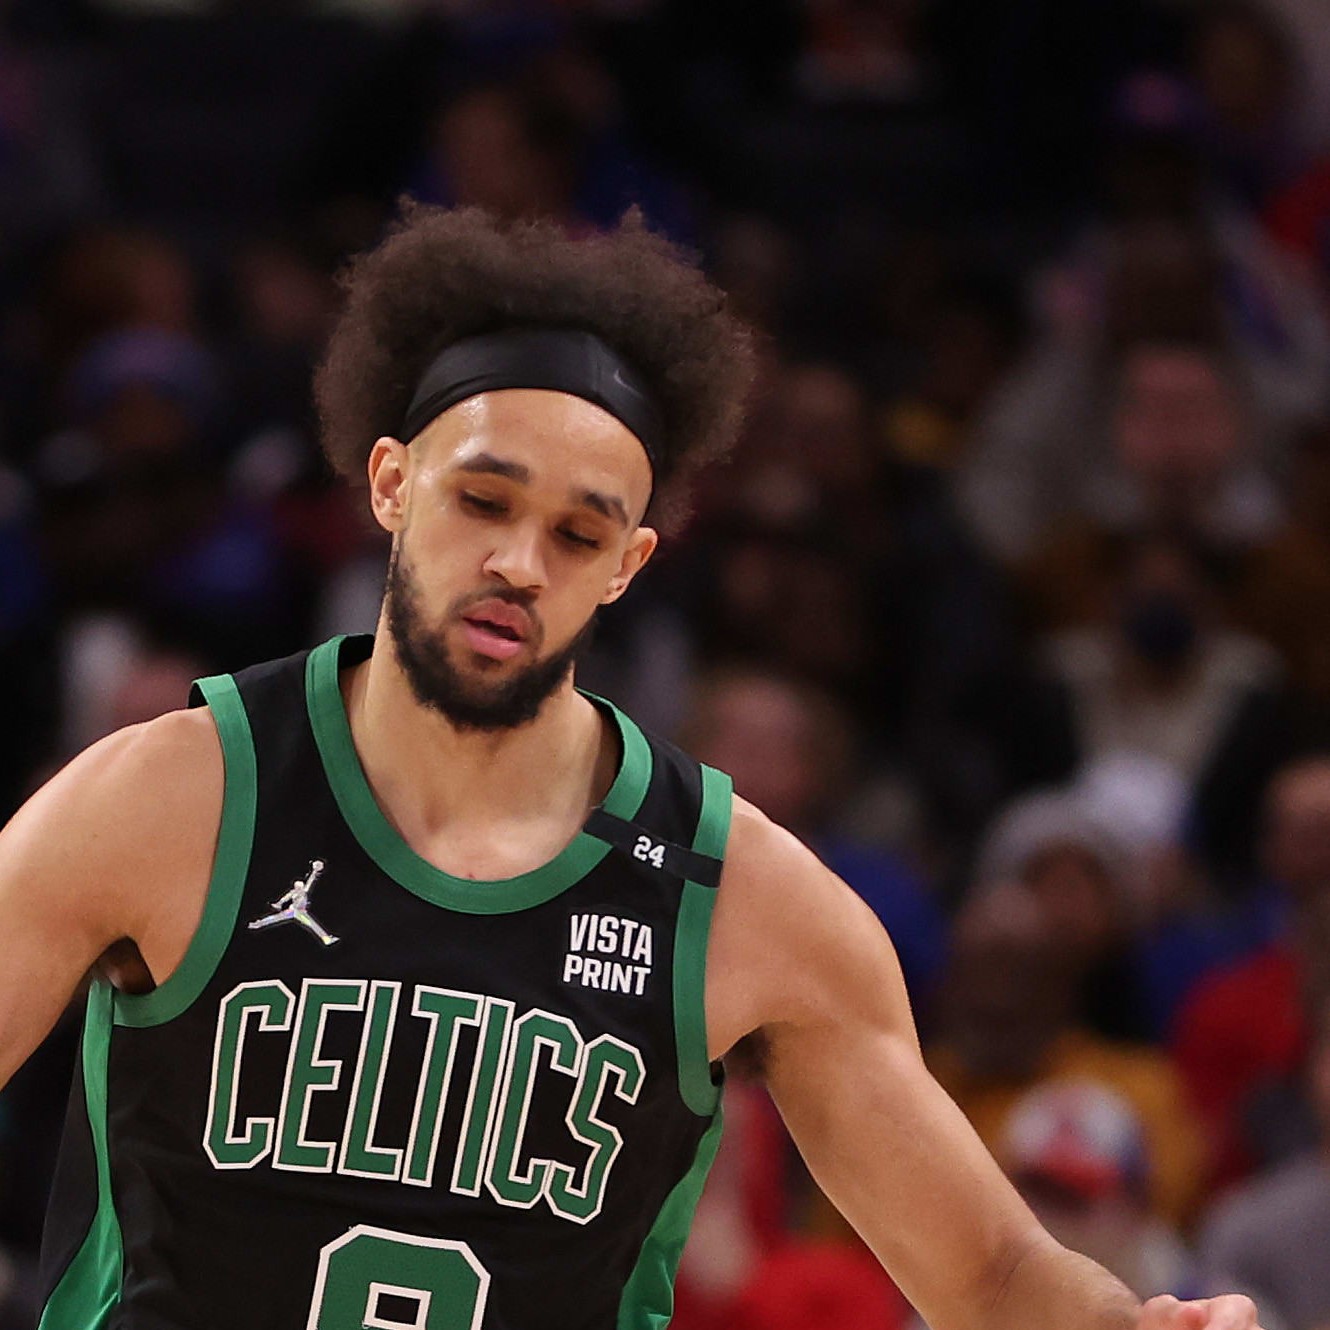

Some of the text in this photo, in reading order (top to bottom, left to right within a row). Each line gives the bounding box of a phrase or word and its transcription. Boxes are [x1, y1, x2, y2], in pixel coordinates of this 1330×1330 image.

[632, 835, 666, 868] 24
[570, 913, 653, 966] VISTA
[562, 953, 652, 996] PRINT
[203, 977, 647, 1225] CELTICS
